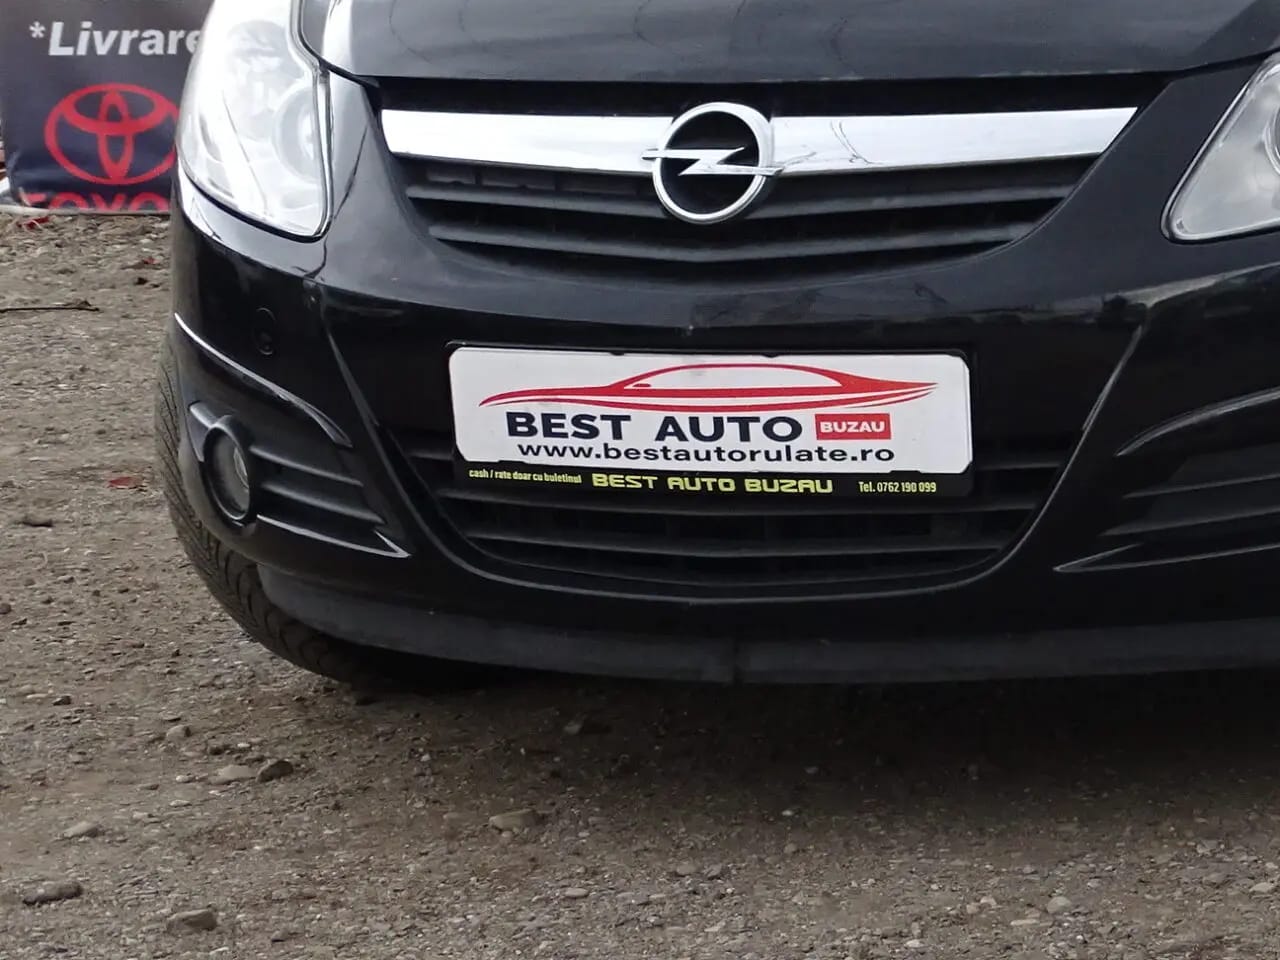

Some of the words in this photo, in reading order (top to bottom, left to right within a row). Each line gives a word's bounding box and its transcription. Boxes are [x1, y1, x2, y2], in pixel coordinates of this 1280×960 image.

[505, 410, 632, 441] BEST
[654, 415, 803, 443] AUTO
[819, 420, 886, 434] BUZAU
[517, 442, 895, 463] www.bestautorulate.ro
[468, 468, 489, 479] cash
[494, 470, 512, 481] rate
[512, 470, 532, 482] doar
[533, 472, 543, 482] cu
[544, 471, 582, 484] buletinul
[591, 473, 658, 489] BEST
[667, 475, 736, 492] AUTO
[744, 477, 833, 493] BUZAU
[858, 480, 876, 493] Tel.
[876, 481, 900, 493] 0762
[901, 481, 917, 493] 190
[918, 481, 937, 493] 099
